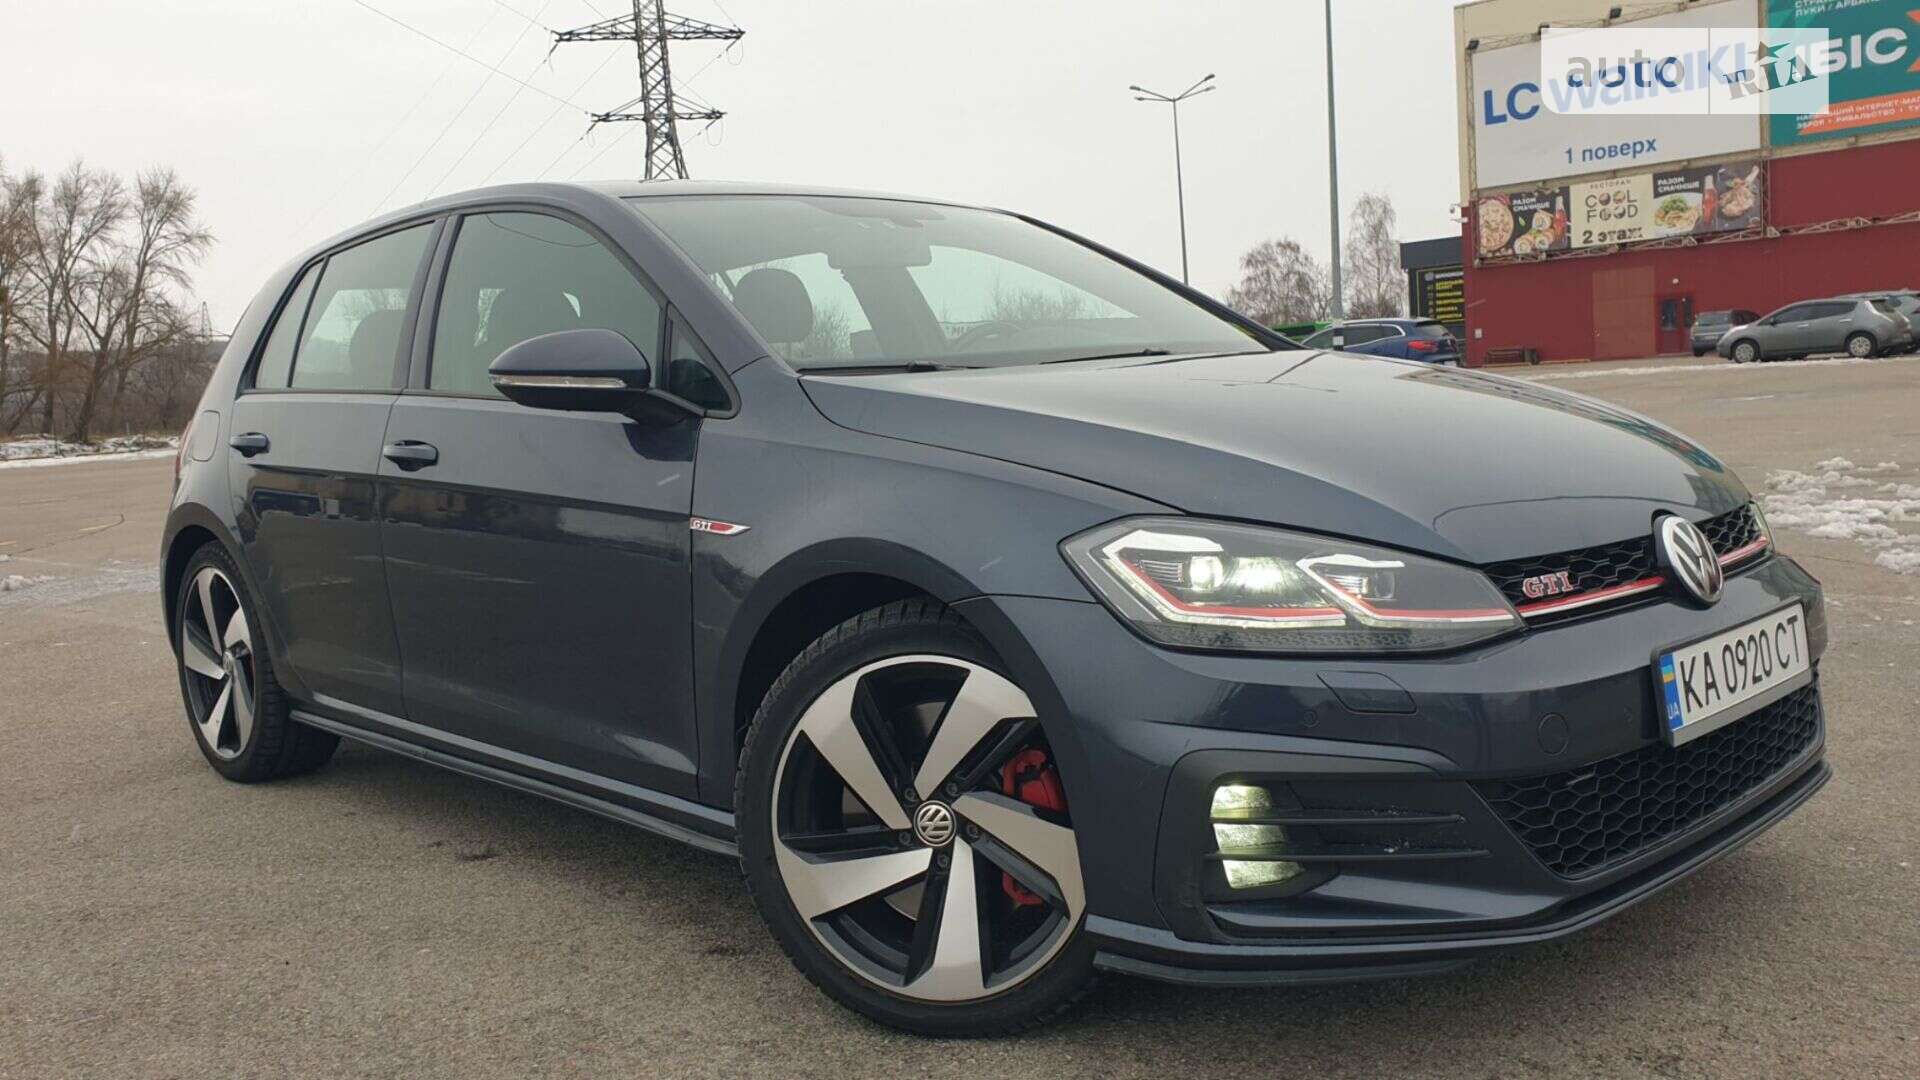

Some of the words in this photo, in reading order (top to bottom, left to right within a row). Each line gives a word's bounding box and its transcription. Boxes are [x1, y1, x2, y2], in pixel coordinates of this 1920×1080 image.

[1484, 82, 1540, 125] LC
[1565, 147, 1573, 164] 1
[1581, 138, 1657, 162] поверх
[1585, 189, 1638, 208] COOL
[1586, 204, 1638, 223] FOOD
[1582, 230, 1594, 245] 2
[692, 519, 712, 531] GTI
[1522, 571, 1576, 598] GTI
[1680, 651, 1721, 713] KA
[1722, 628, 1773, 694] 0920
[1775, 614, 1800, 669] CT
[1667, 702, 1681, 719] UA
